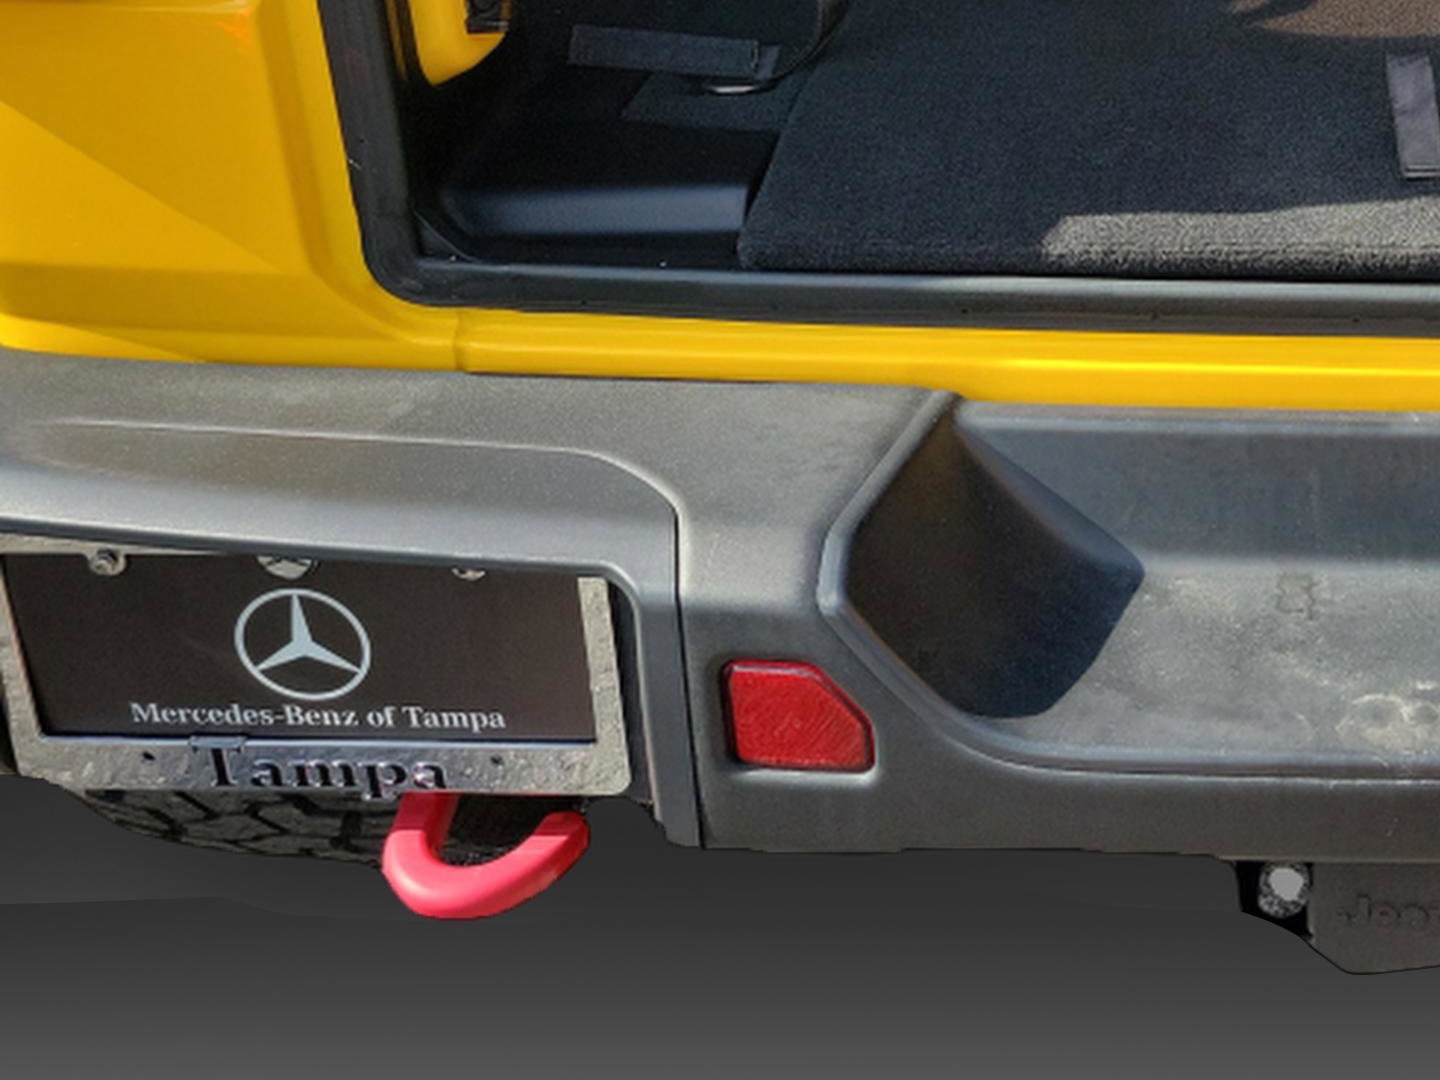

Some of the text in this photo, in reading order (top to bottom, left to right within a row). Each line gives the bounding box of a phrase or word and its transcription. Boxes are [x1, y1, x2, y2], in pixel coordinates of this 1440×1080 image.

[130, 701, 506, 734] Mercedes-Benz of Tampa
[189, 735, 449, 801] Tampa
